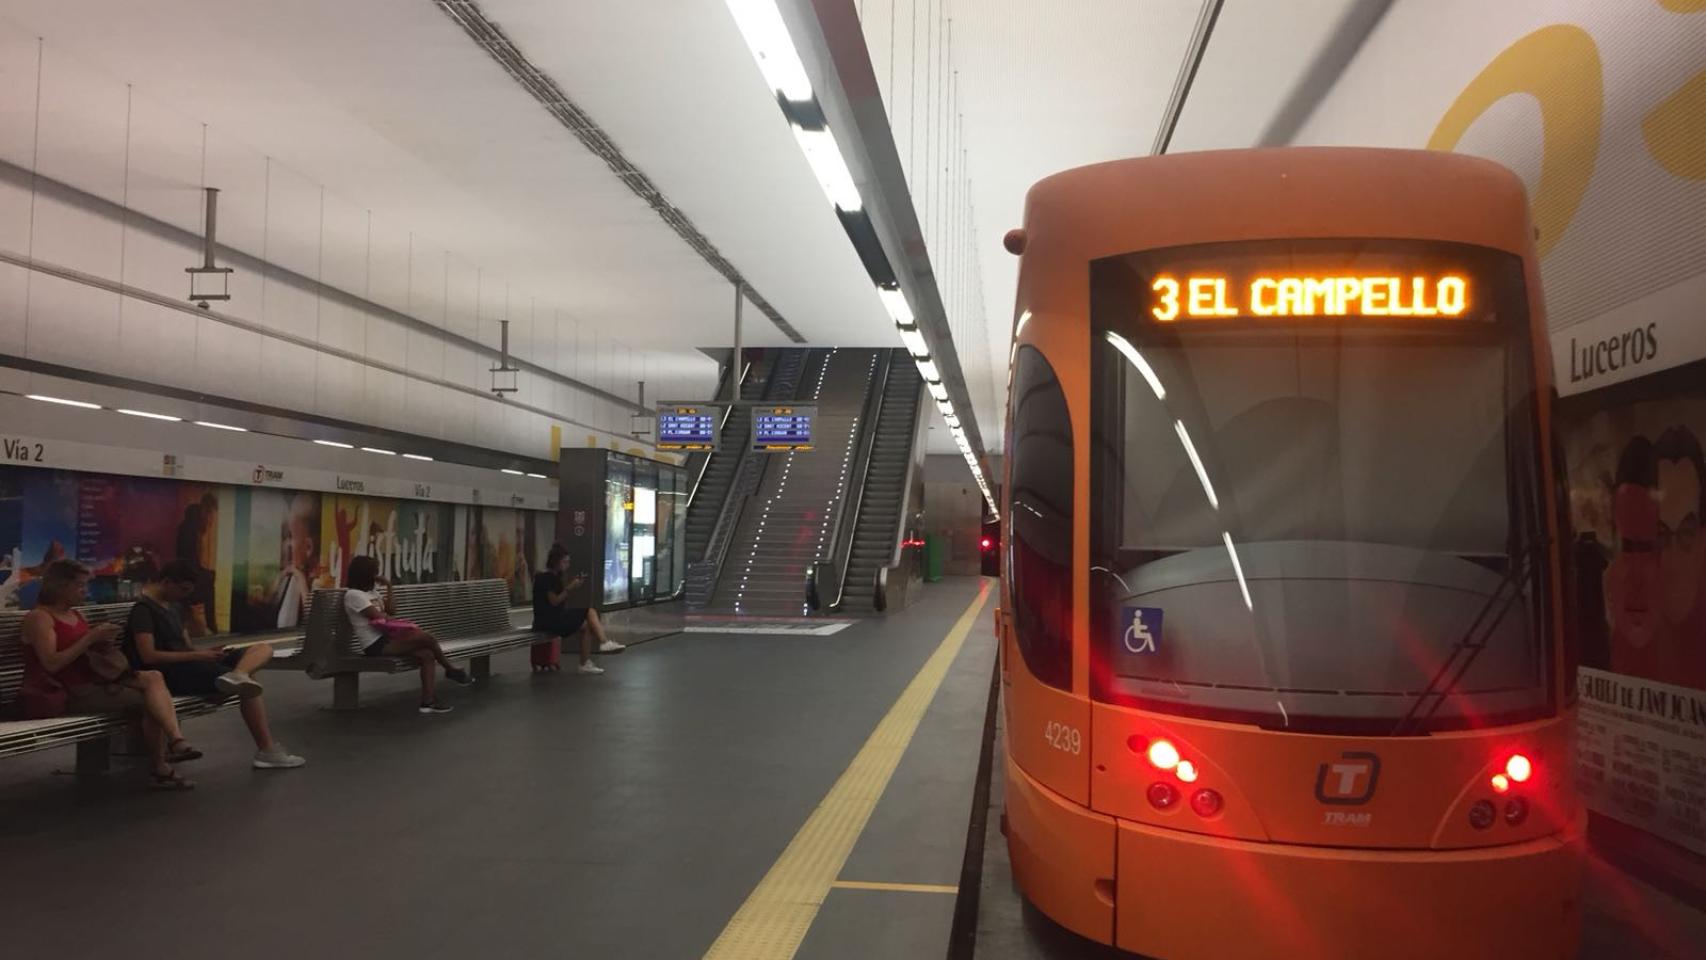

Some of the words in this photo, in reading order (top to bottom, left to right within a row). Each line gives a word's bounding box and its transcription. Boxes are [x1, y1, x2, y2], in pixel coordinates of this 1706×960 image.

[1151, 277, 1180, 321] 3
[1187, 277, 1239, 316] EL
[1250, 275, 1467, 316] CAMPELLO
[1570, 322, 1658, 384] Luceros
[4, 438, 29, 461] Vía
[34, 443, 44, 463] 2
[336, 475, 365, 493] Luceros
[426, 485, 432, 498] 2
[1044, 720, 1081, 755] 4239
[1323, 811, 1373, 828] TRAM
